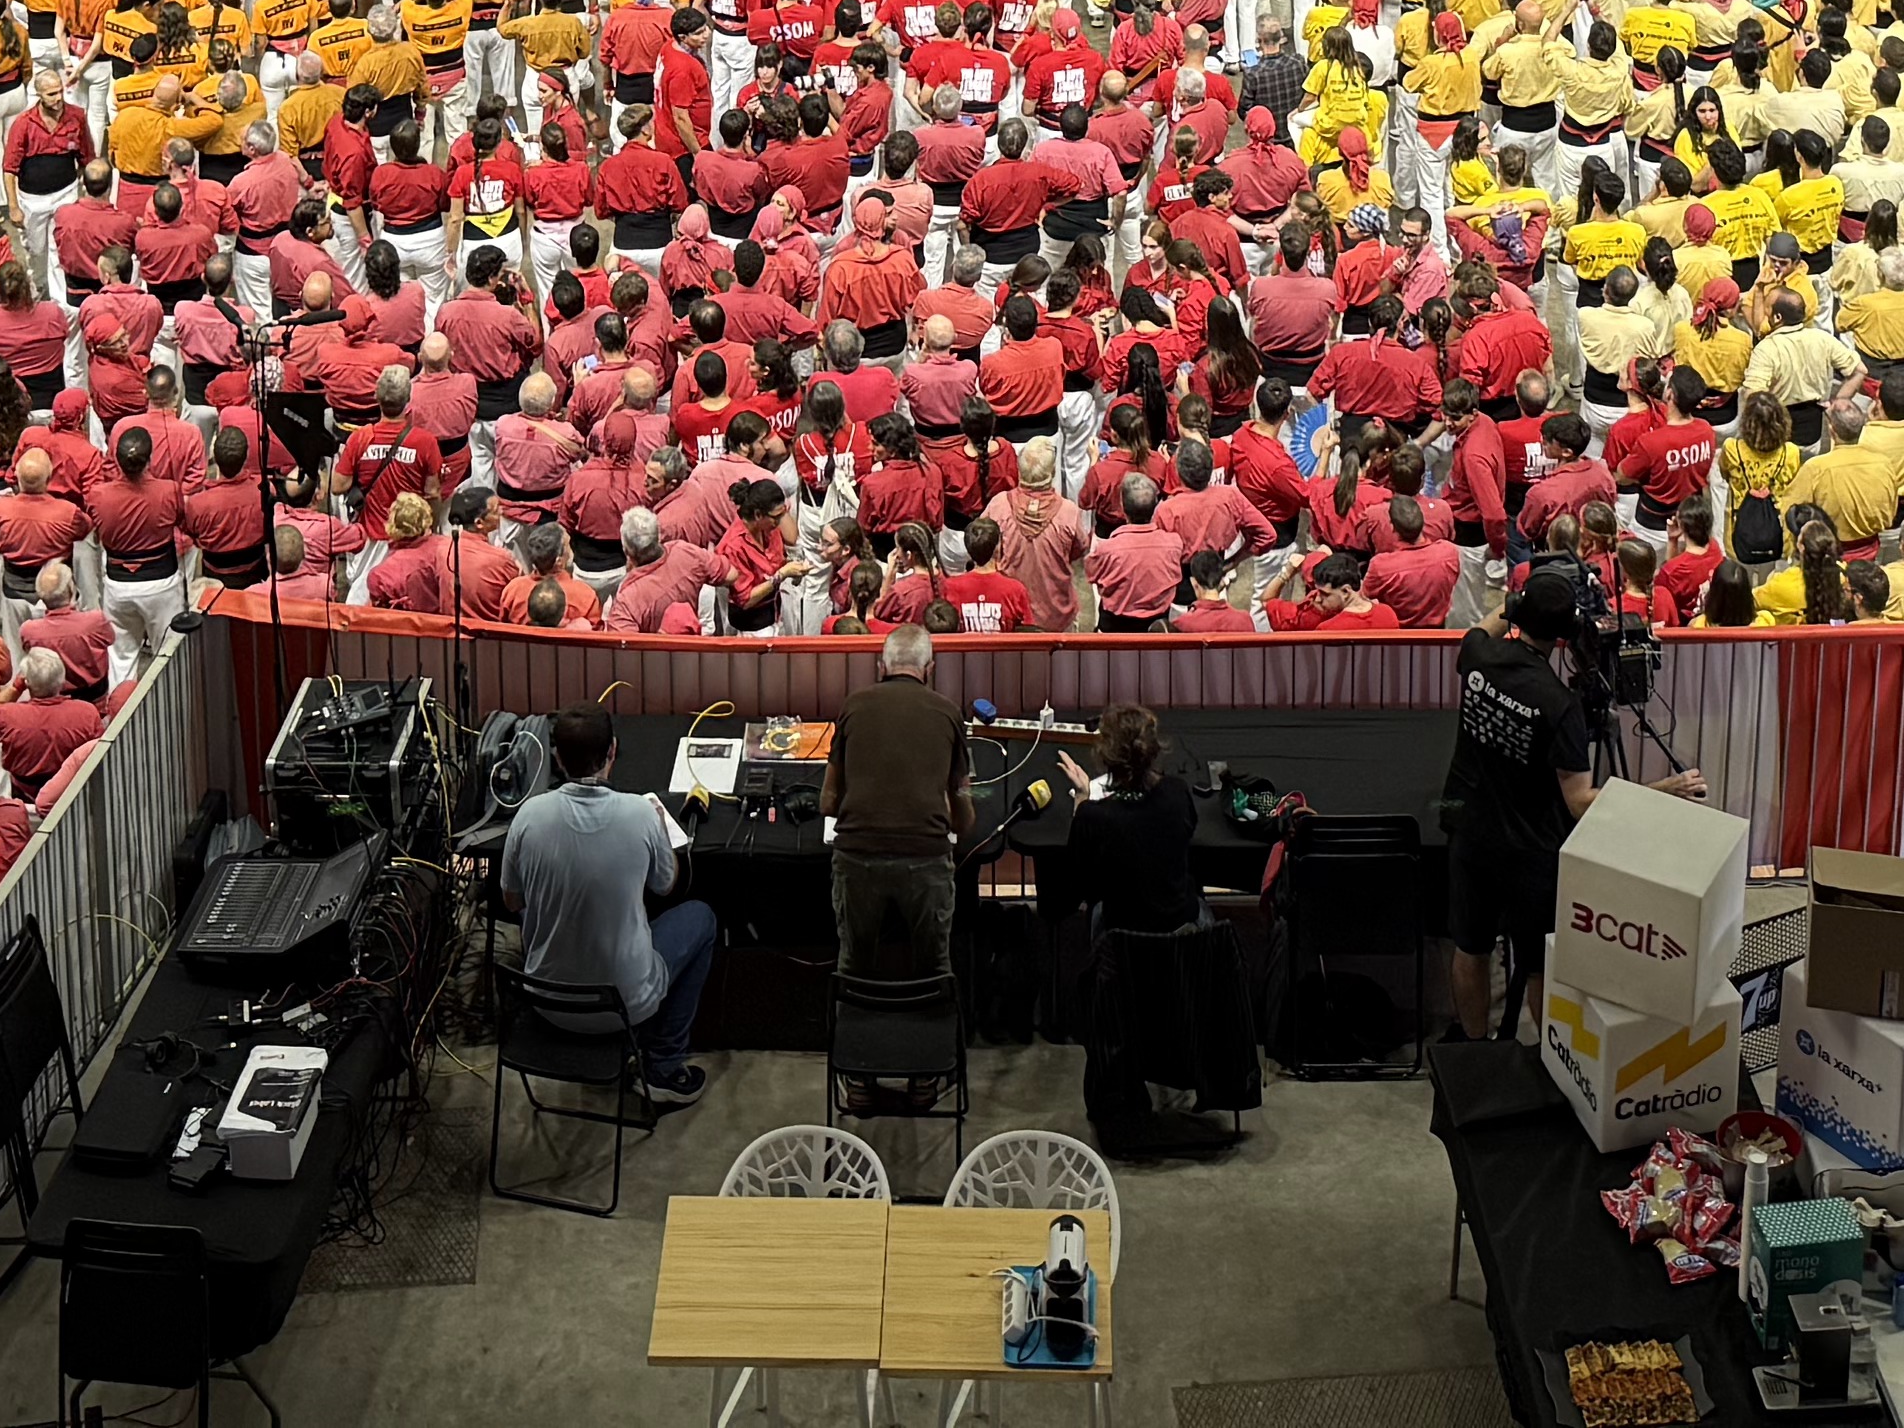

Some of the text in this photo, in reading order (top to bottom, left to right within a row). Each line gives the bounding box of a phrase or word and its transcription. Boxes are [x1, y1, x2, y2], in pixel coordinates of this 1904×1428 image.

[1682, 441, 1710, 467] SOM
[1570, 901, 1659, 960] 3cat
[1815, 1043, 1831, 1062] la
[1615, 1081, 1722, 1121] Catràdio
